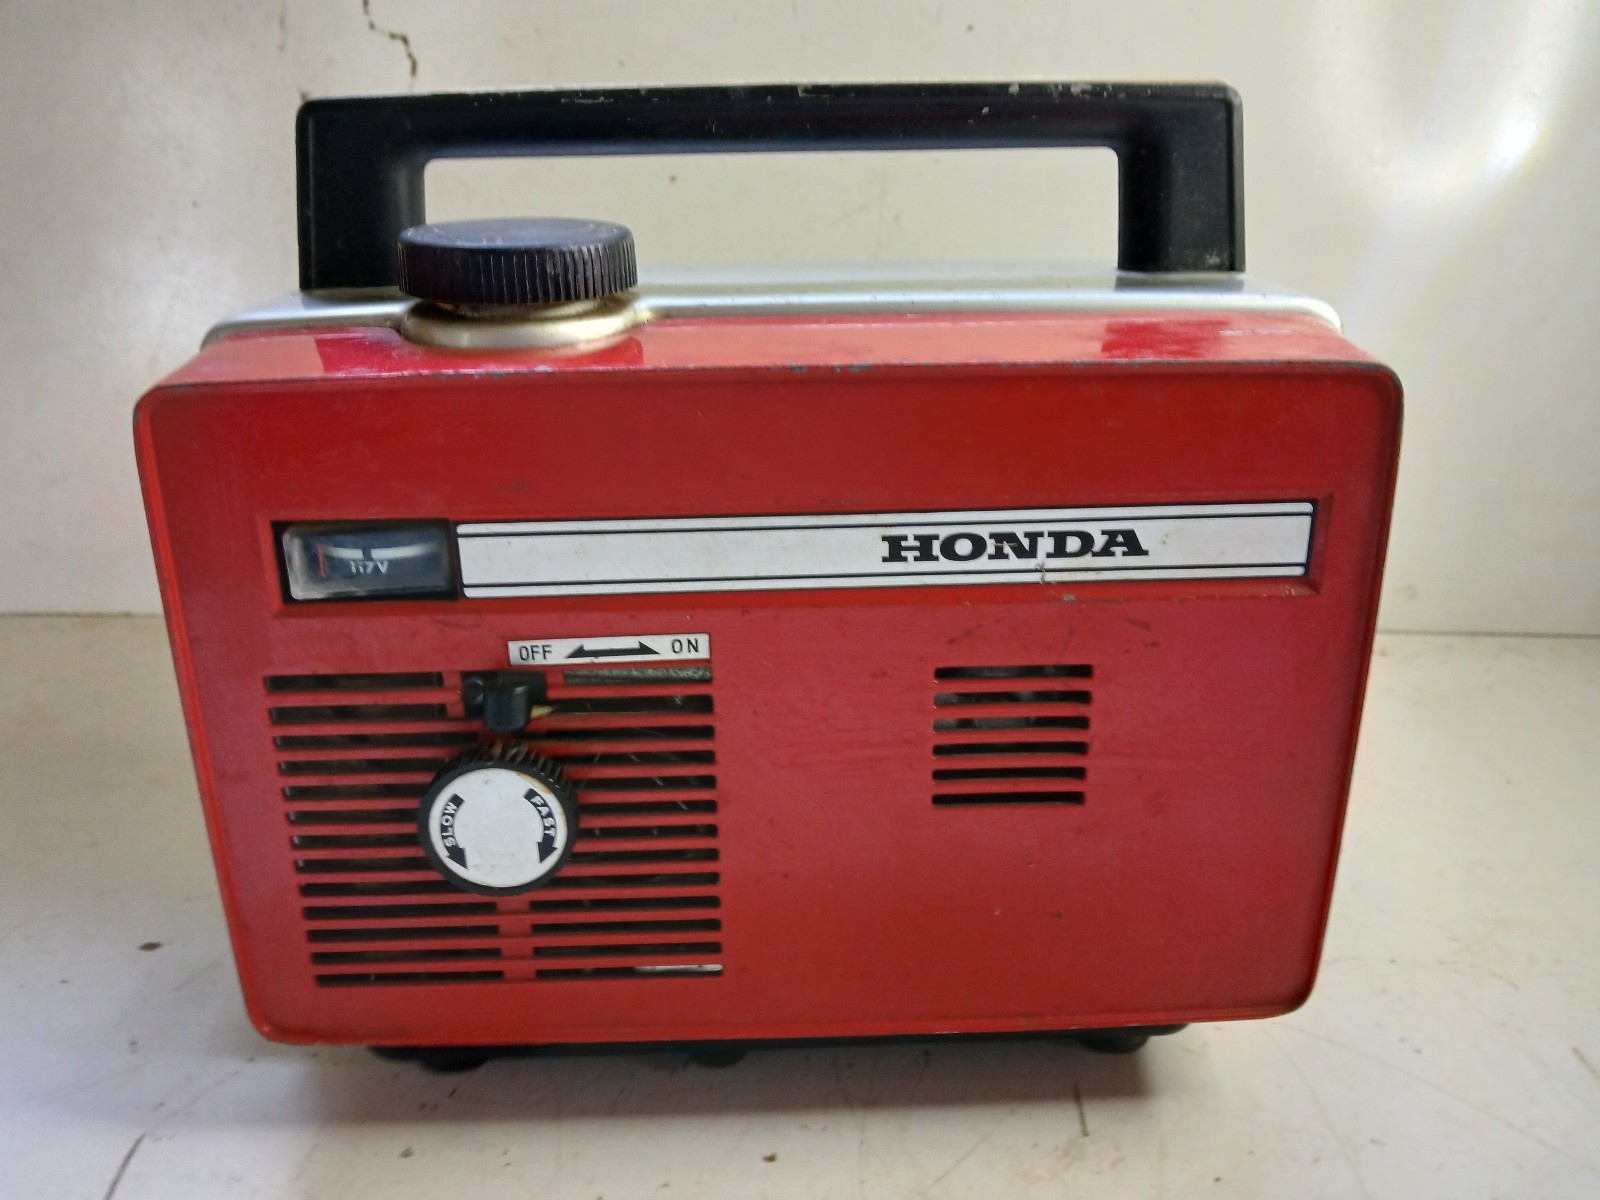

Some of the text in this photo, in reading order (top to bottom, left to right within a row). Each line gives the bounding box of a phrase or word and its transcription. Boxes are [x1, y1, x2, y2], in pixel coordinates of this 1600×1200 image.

[881, 529, 1149, 562] HONDA
[518, 638, 699, 661] OFF ON
[441, 801, 459, 848] SLOW
[530, 795, 556, 837] FAST
